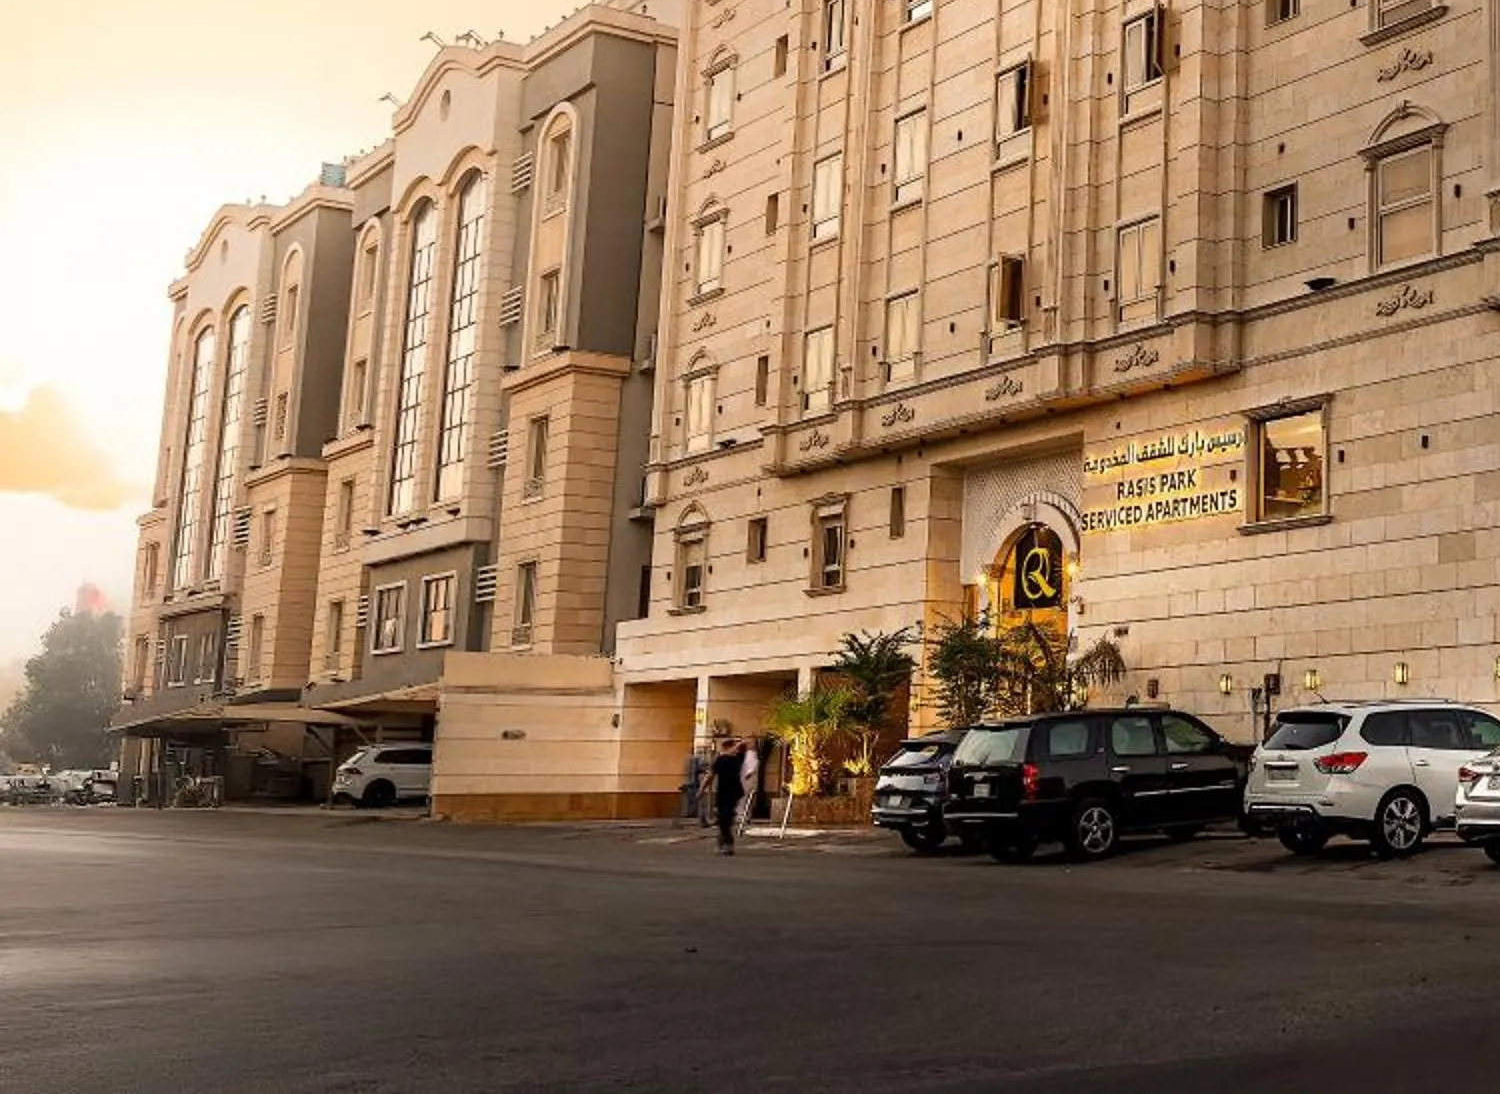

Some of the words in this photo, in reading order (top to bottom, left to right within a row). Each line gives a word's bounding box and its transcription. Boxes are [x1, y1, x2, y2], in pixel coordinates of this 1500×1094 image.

[1136, 436, 1175, 464] للشقق
[1177, 431, 1205, 458] بارك
[1207, 428, 1245, 455] رسيس
[1083, 443, 1135, 475] المخدومة
[1117, 476, 1156, 501] RASIS
[1160, 469, 1197, 493] PARK
[1080, 505, 1143, 532] SERVICED
[1145, 489, 1237, 523] APARTMENTS
